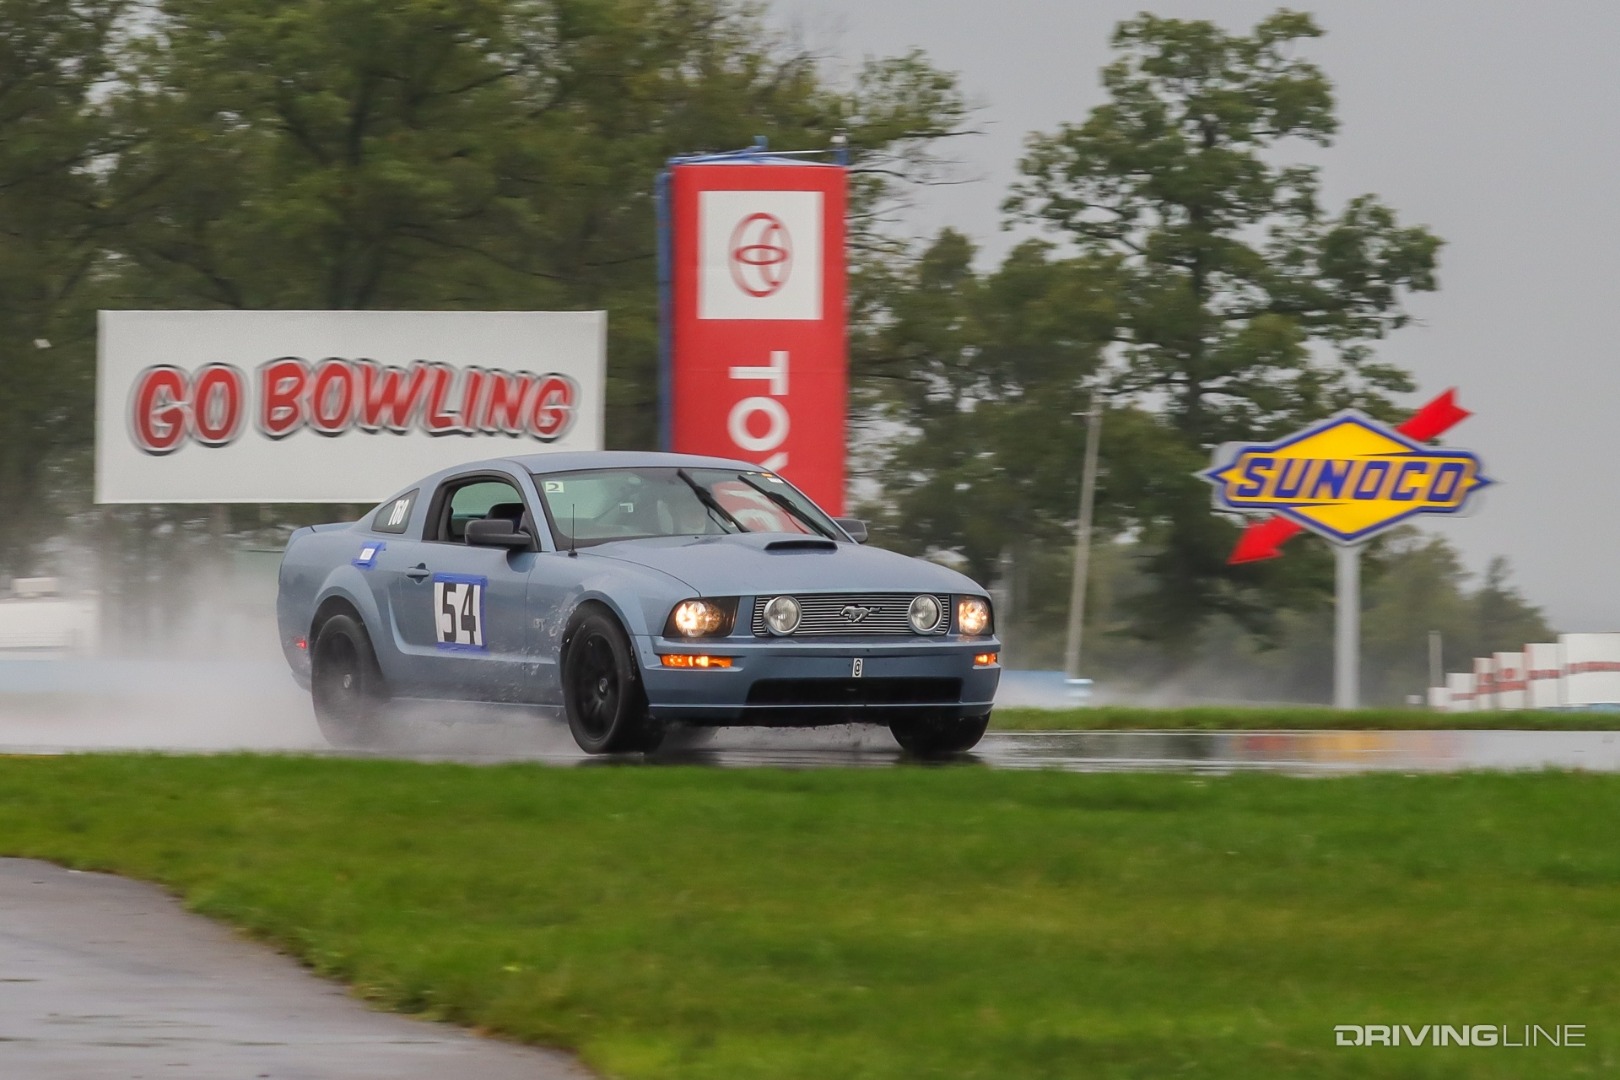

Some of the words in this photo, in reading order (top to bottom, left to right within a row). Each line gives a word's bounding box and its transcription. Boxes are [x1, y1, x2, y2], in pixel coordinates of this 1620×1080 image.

[132, 365, 246, 454] GO
[259, 358, 576, 442] BOWLING
[1236, 457, 1466, 502] SUNOCO
[442, 582, 477, 645] 54
